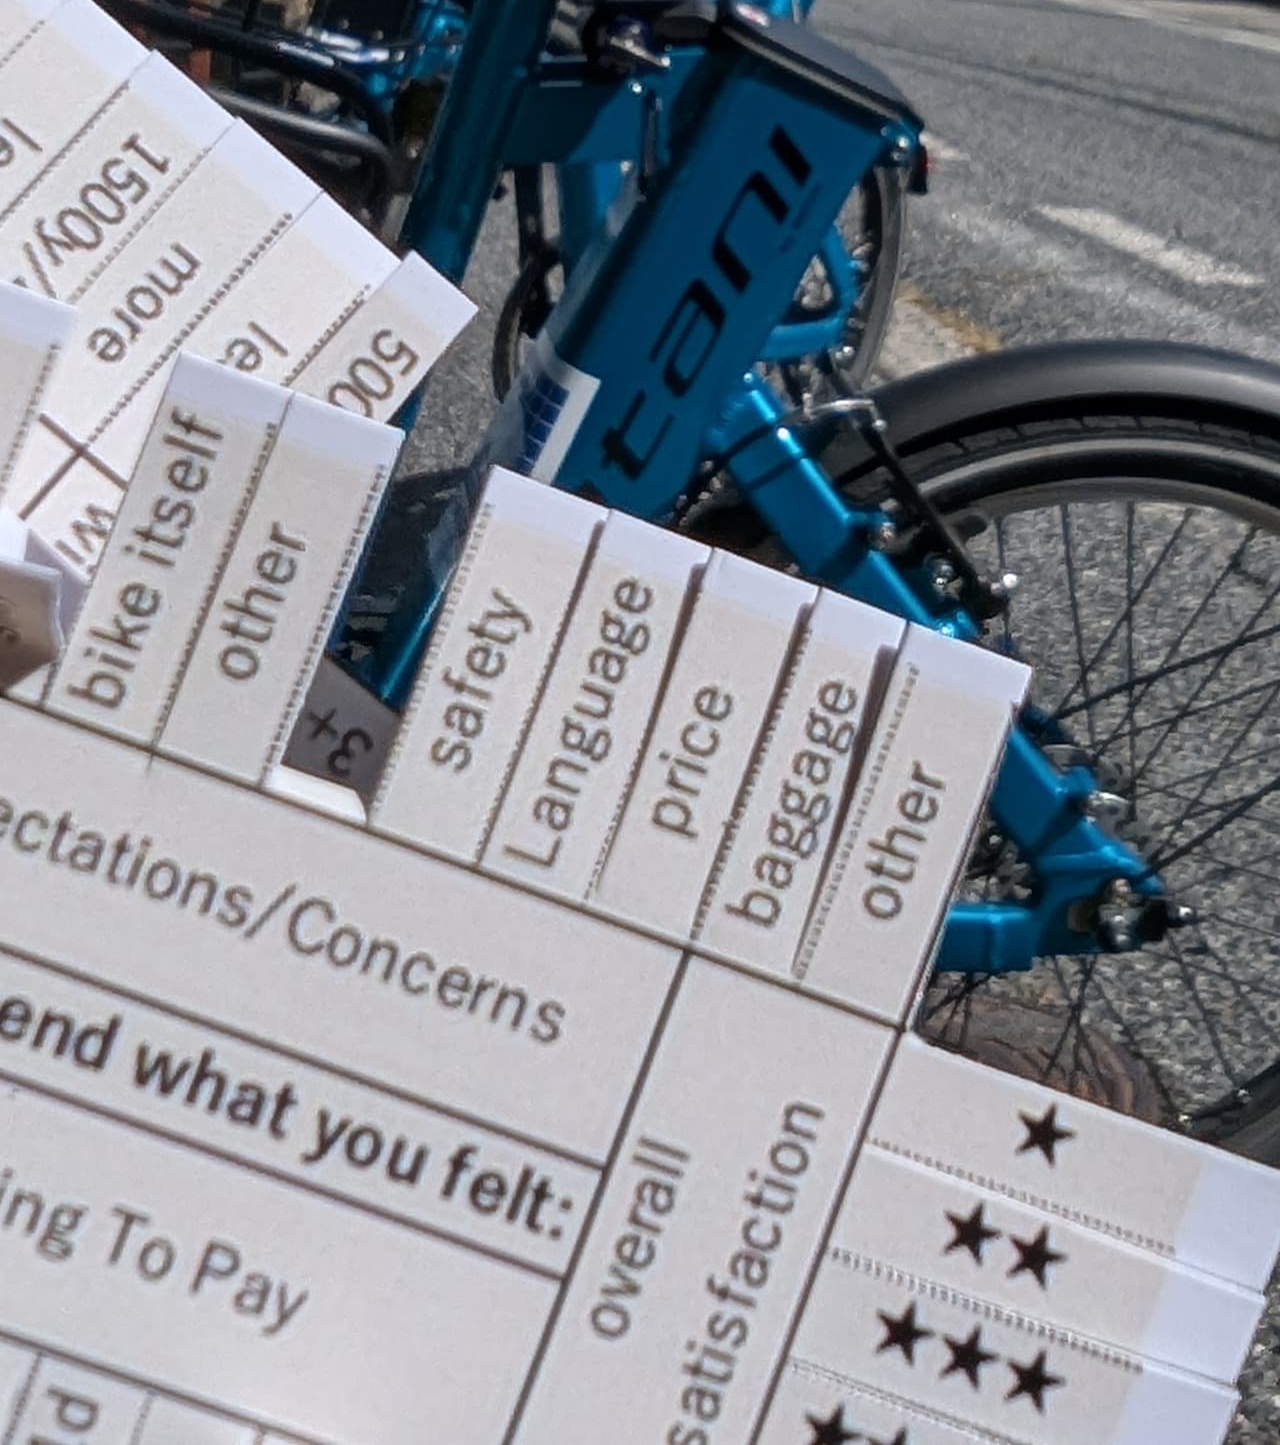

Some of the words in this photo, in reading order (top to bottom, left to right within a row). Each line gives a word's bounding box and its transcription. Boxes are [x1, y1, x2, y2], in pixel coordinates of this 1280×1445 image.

[23, 134, 170, 299] 1500y/
[87, 243, 201, 362] more
[602, 123, 812, 480] tani
[328, 329, 419, 417] 500
[67, 581, 161, 707] bike
[124, 403, 224, 567] itself
[220, 522, 307, 681] other
[430, 586, 534, 773] safety
[503, 575, 654, 870] Language
[651, 683, 734, 840] price
[727, 680, 858, 930] baggage
[864, 760, 948, 921] other
[132, 1040, 300, 1139] what
[300, 1108, 420, 1186] you
[439, 1147, 575, 1241] felt:
[111, 1205, 174, 1282] To
[188, 1239, 308, 1337] Pay
[589, 1135, 690, 1340] overall
[668, 1099, 825, 1445] satisfaction
